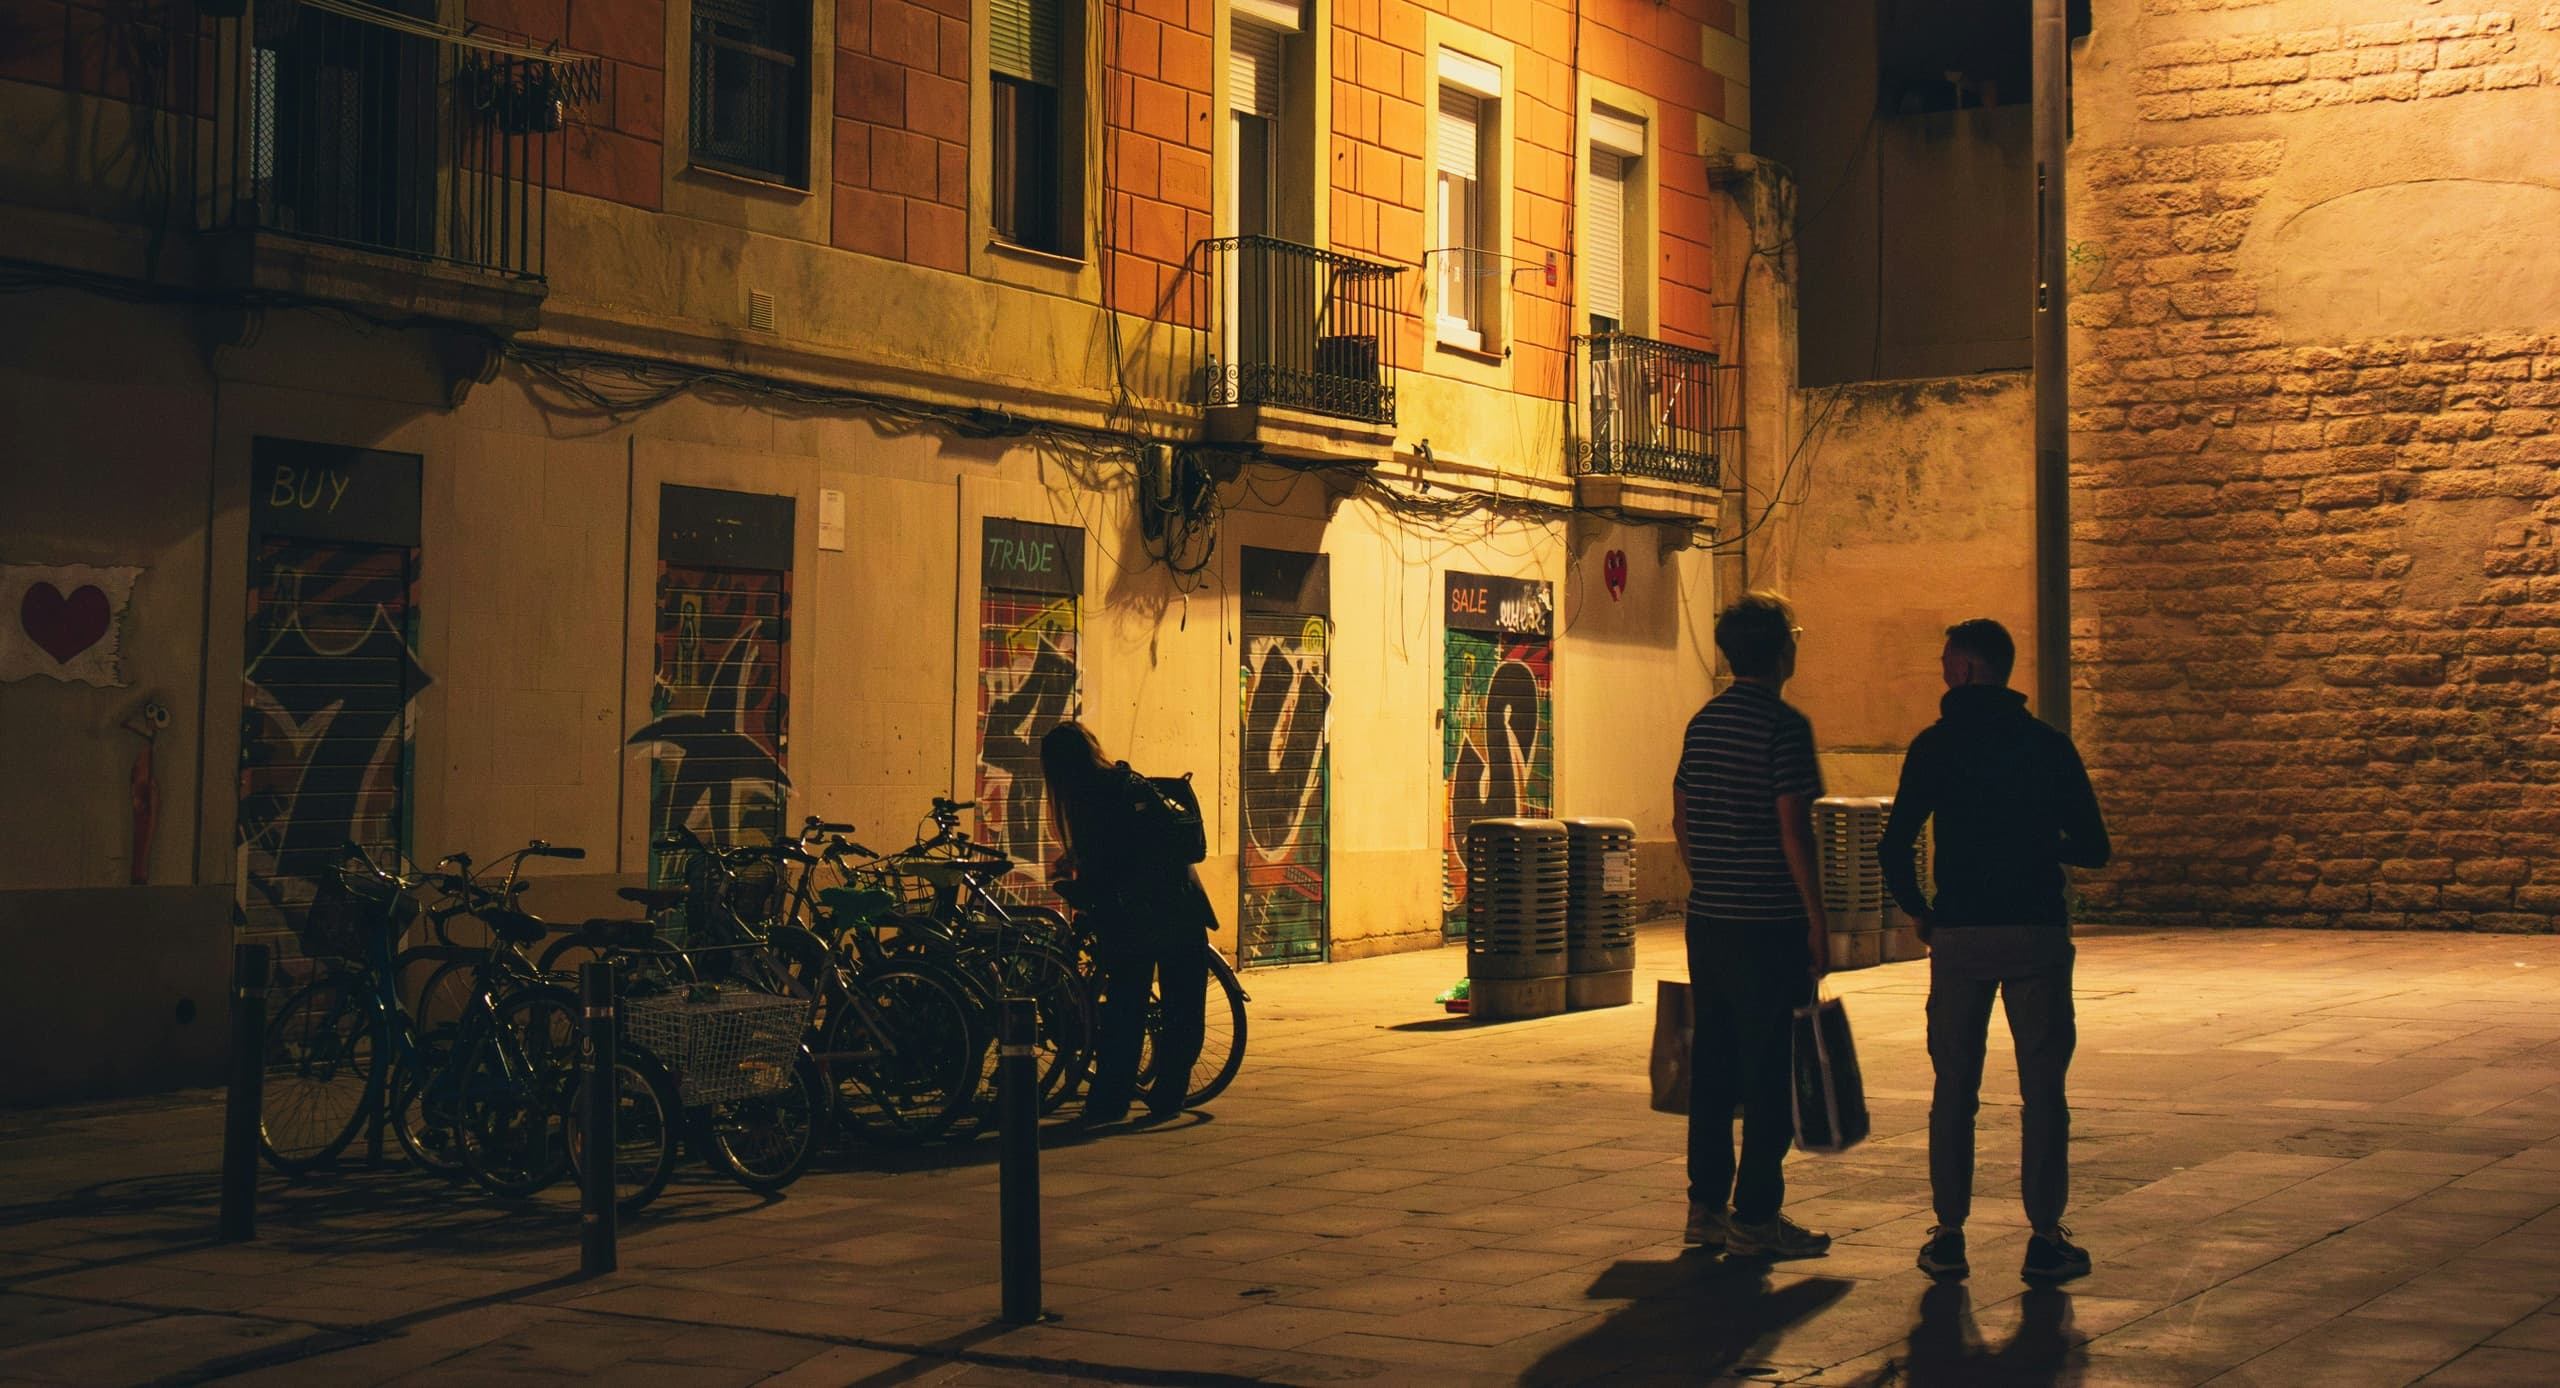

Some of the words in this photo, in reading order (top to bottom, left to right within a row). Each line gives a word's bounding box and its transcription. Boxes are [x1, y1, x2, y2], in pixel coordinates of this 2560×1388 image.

[270, 465, 350, 513] BUY
[989, 538, 1055, 572] TRADE
[1451, 588, 1488, 614] SALE
